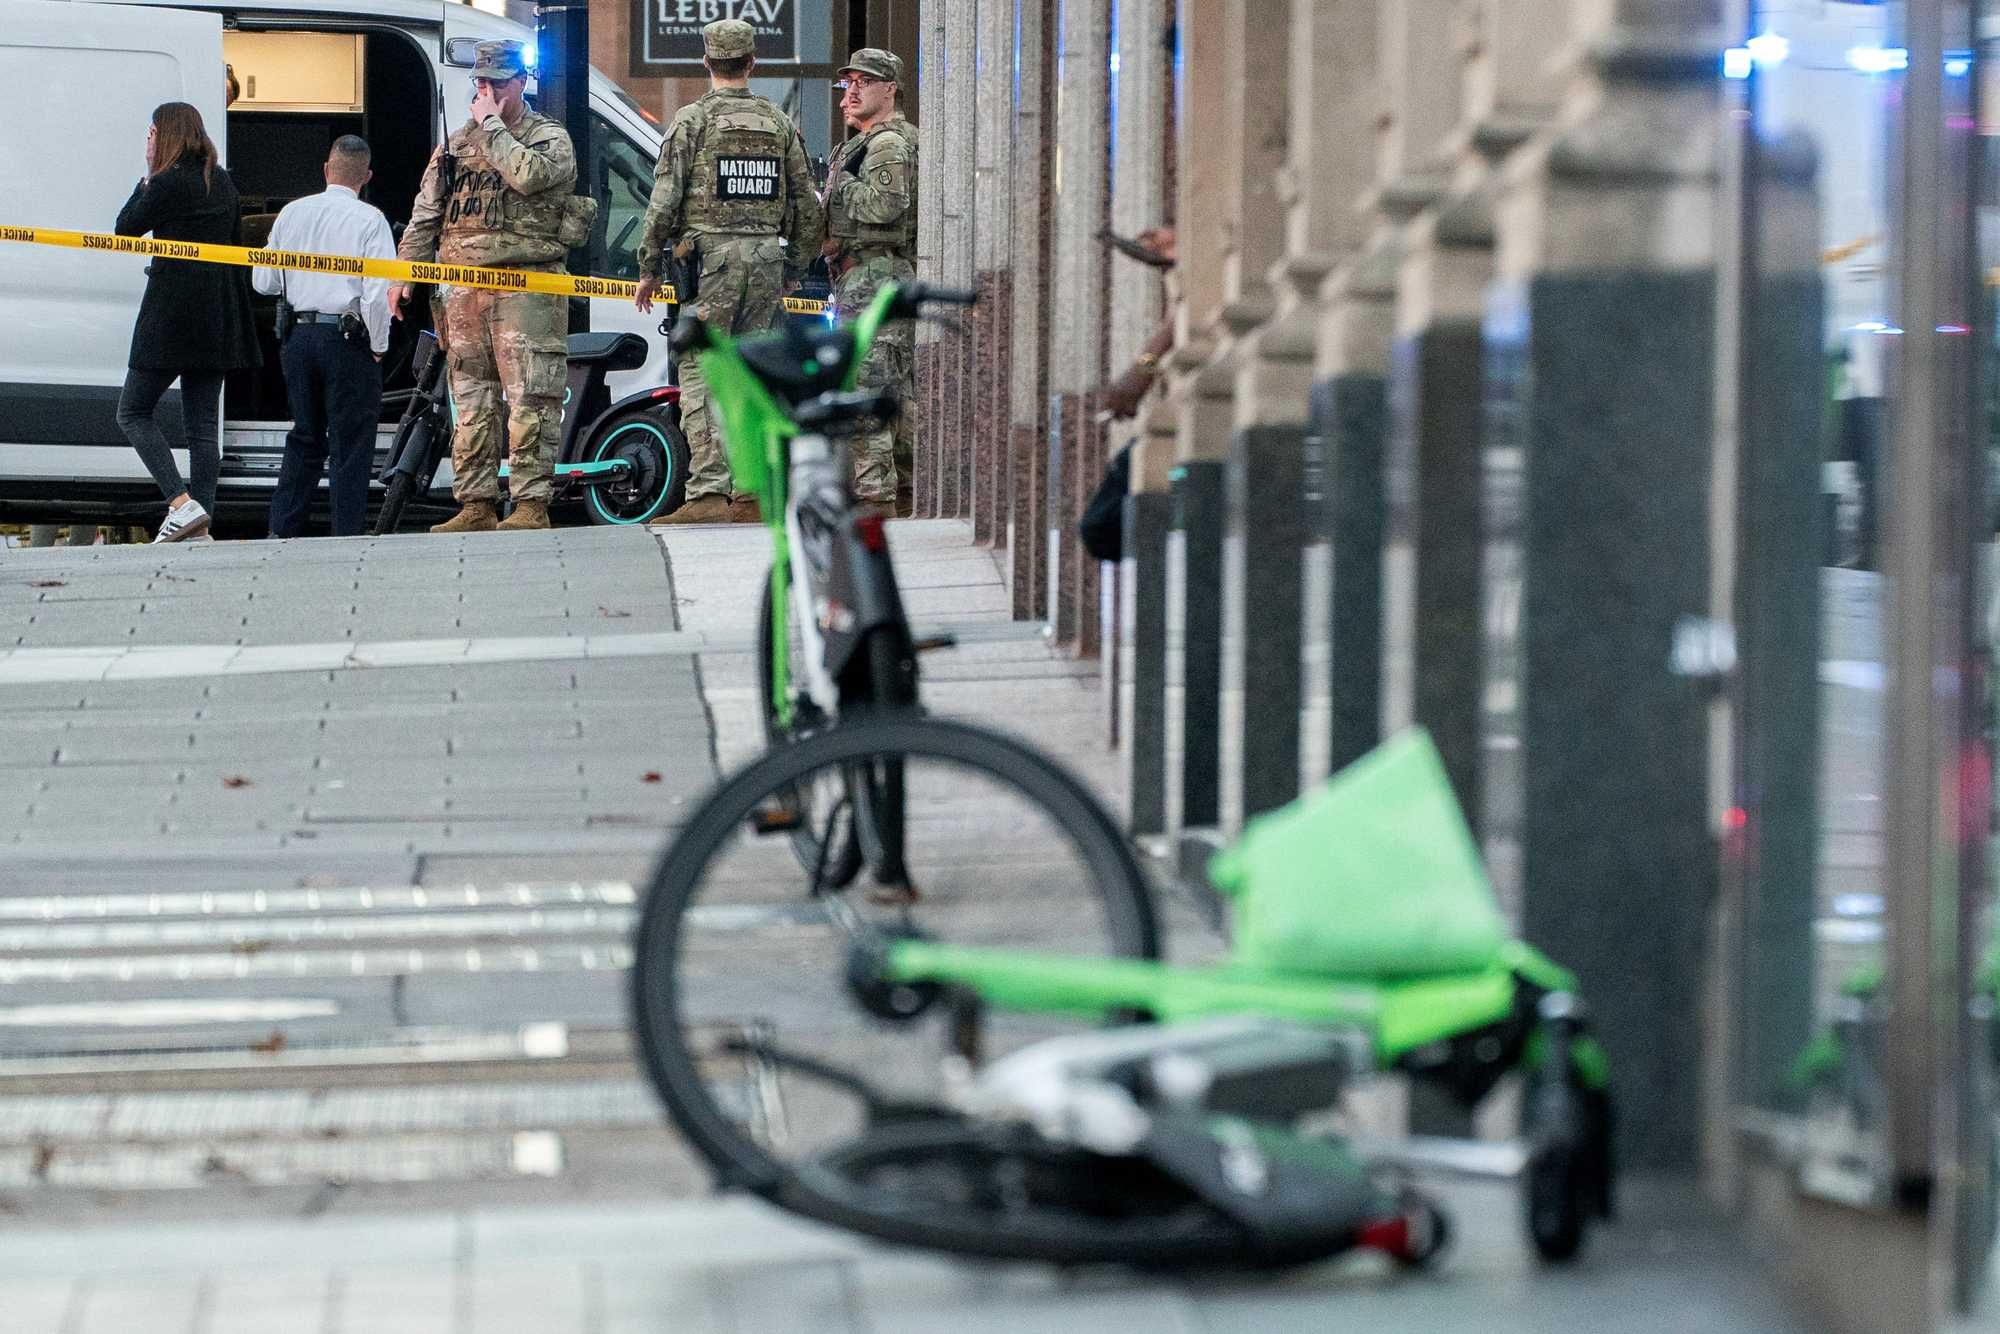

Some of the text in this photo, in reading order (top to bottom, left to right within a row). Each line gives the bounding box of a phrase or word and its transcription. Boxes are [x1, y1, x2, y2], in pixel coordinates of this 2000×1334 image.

[657, 0, 784, 23] LEBTAV
[720, 159, 778, 177] NATIONAL
[727, 178, 772, 195] GUARD
[3, 228, 34, 242] POLICE
[82, 235, 199, 258] POLICE LINE DO NOT CROSS
[247, 251, 363, 273] POLICE LINE DO NOT CROSS
[411, 265, 527, 288] POLICE LINE DO NOT CROSS
[574, 279, 604, 294] CROSS
[606, 282, 623, 296] NOT
[625, 284, 637, 297] DO
